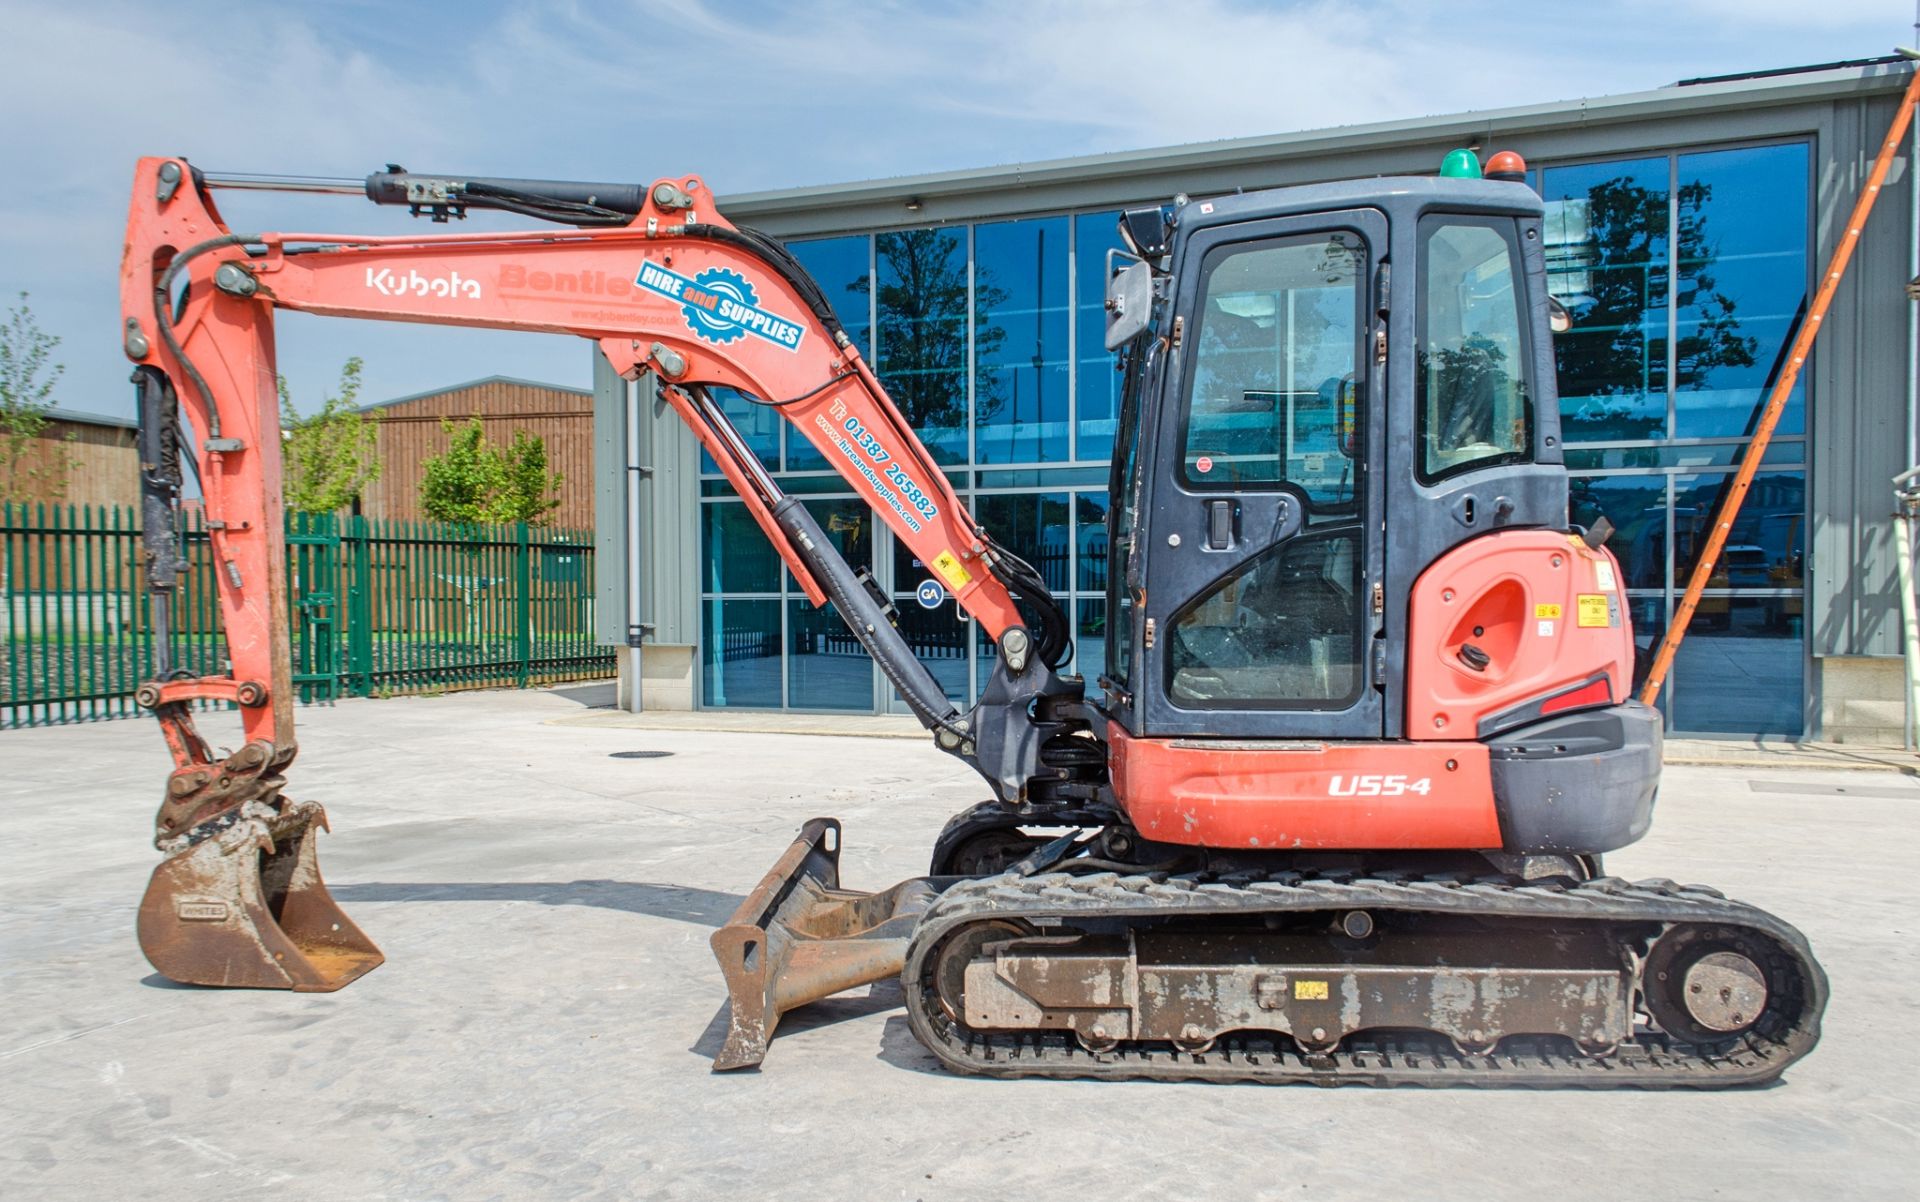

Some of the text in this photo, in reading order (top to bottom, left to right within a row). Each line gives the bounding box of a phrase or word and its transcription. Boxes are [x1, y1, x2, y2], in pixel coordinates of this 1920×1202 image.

[366, 268, 481, 298] Kubota
[640, 266, 799, 345] HIRE and SUPPLIES
[815, 414, 922, 533] www.hireandsupplies.com
[829, 398, 938, 520] T: 01387 265882
[1328, 775, 1431, 796] U55-4
